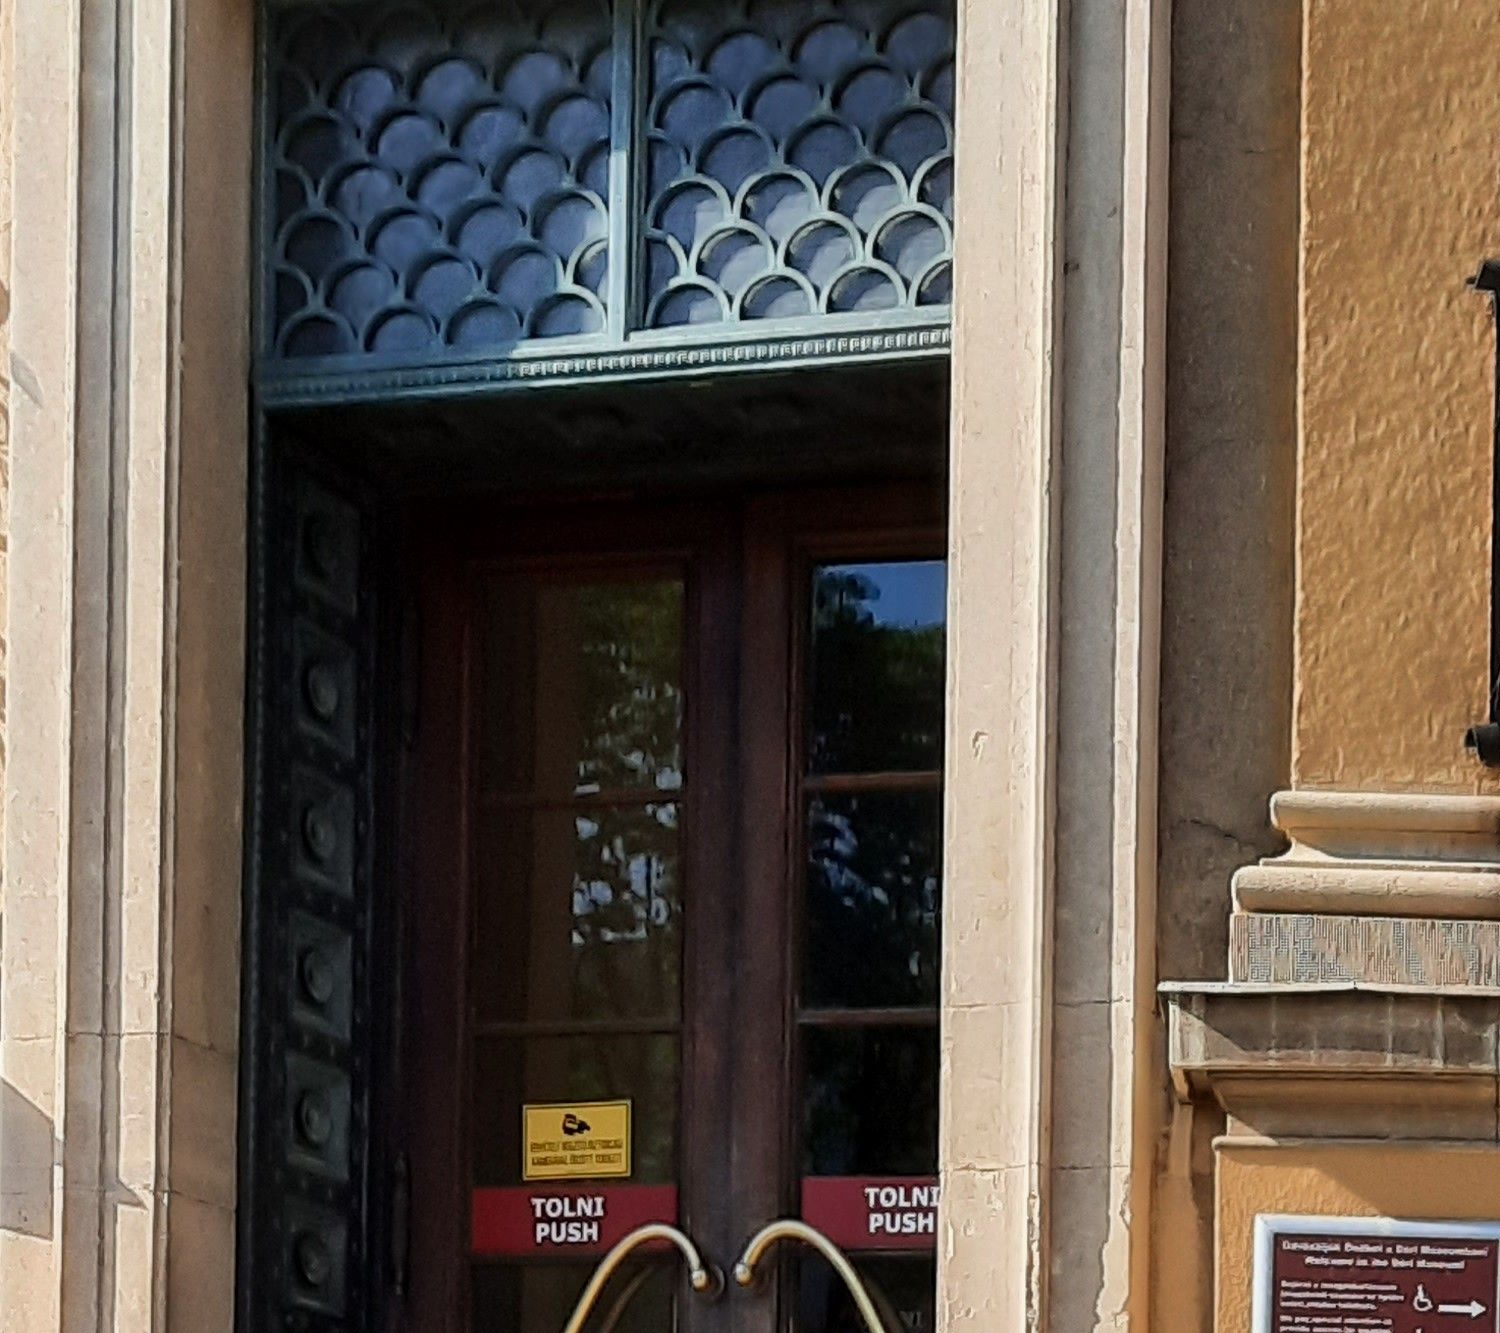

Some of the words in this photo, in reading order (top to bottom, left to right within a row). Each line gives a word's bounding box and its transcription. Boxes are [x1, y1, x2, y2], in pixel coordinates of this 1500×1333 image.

[531, 1196, 604, 1217] TOLNI
[865, 1186, 939, 1208] TOLNI
[536, 1221, 598, 1243] PUSH
[869, 1212, 934, 1233] PUSH
